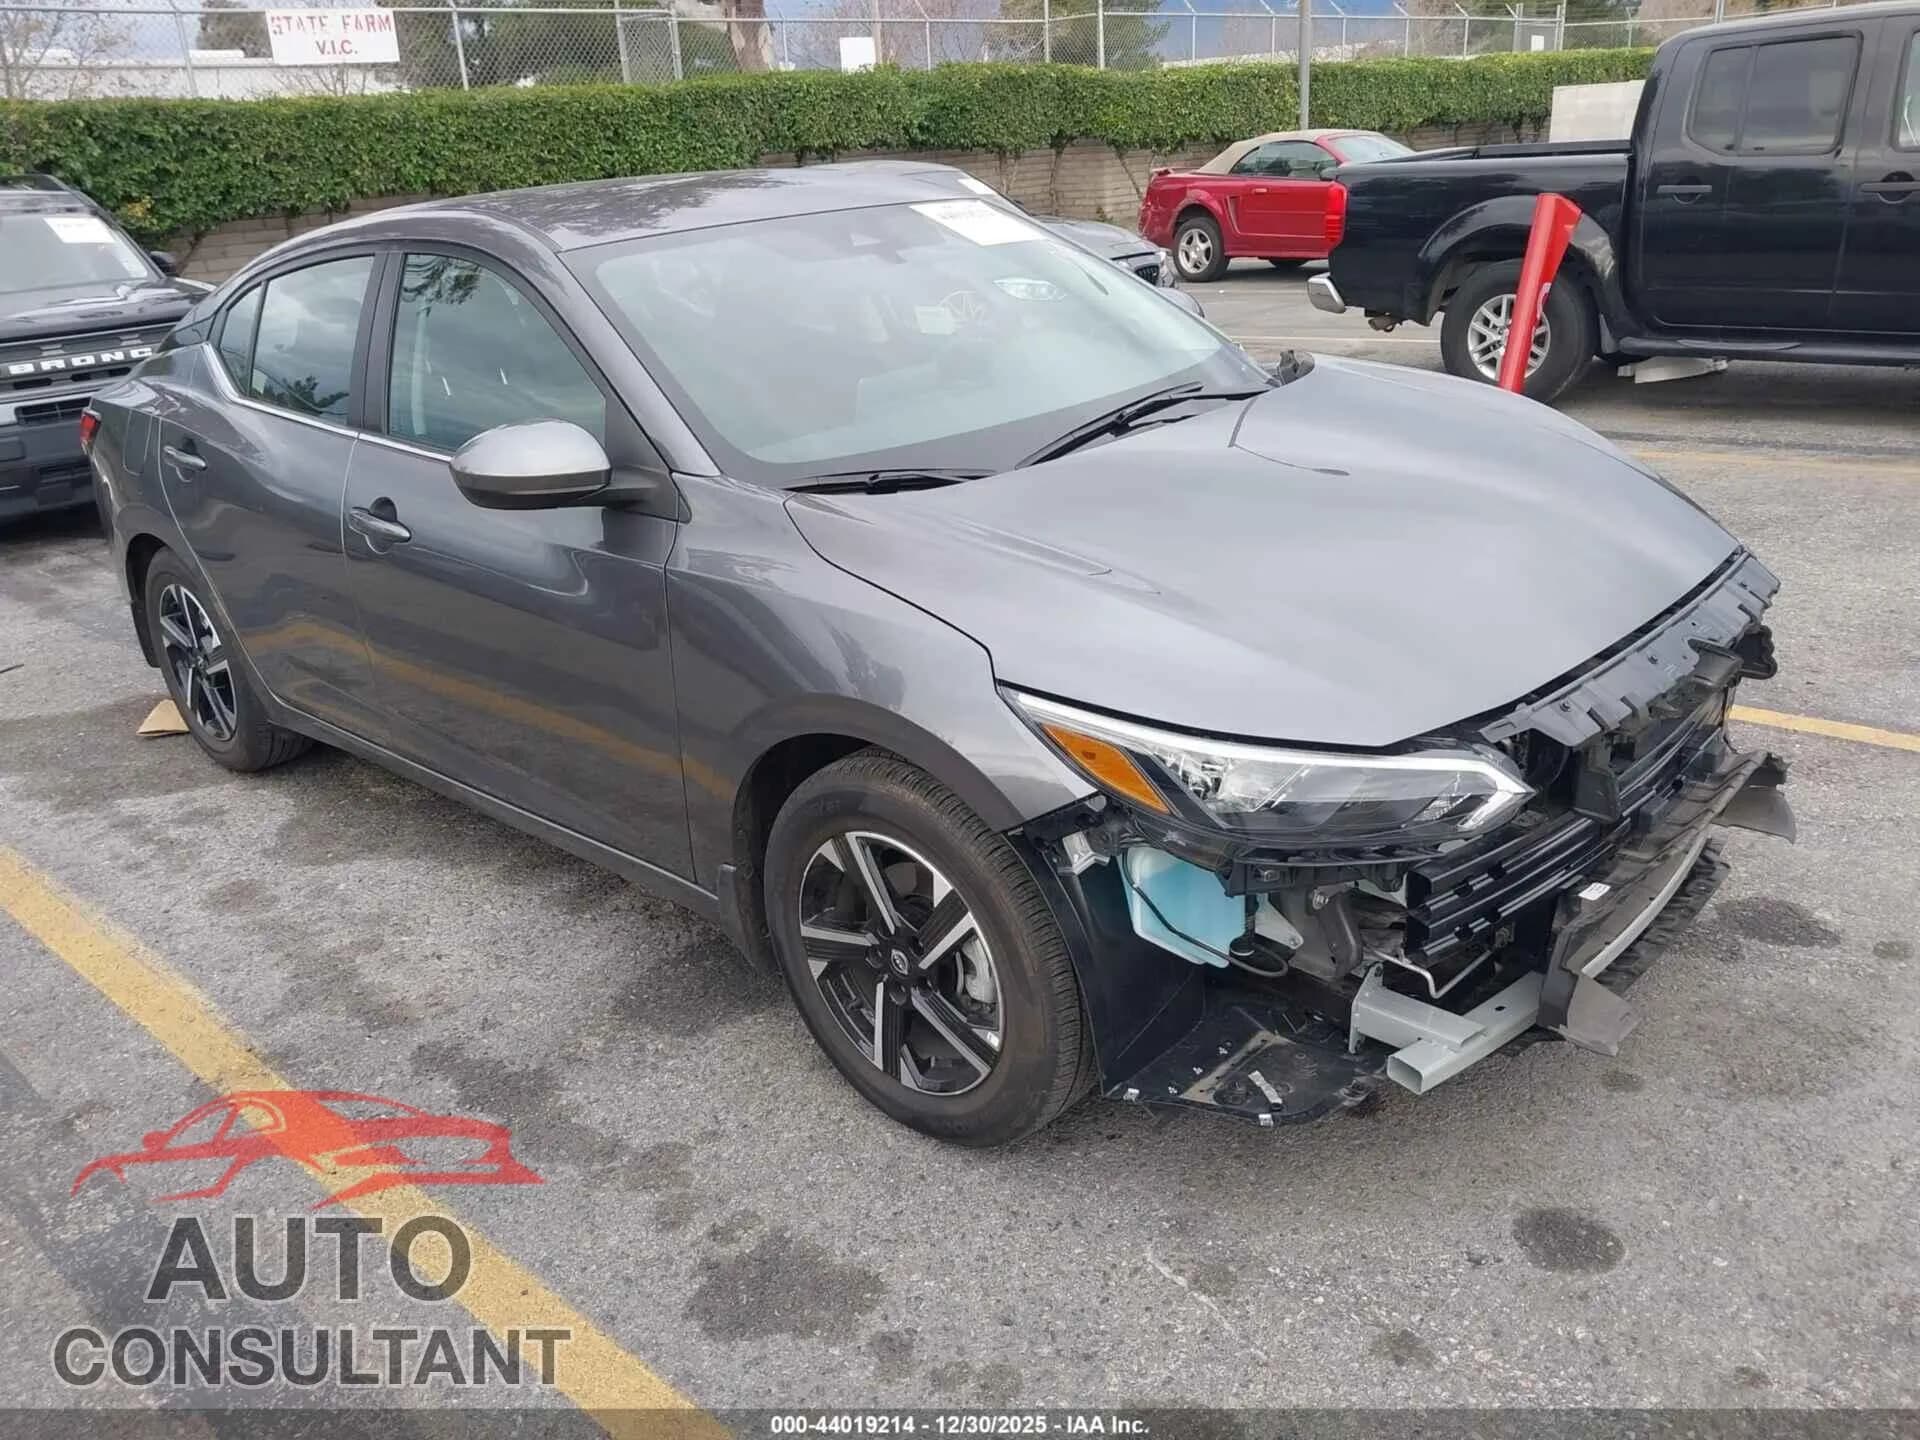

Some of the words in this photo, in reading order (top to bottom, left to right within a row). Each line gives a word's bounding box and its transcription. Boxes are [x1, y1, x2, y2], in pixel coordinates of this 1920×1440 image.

[271, 15, 328, 35] STATE
[341, 14, 392, 33] FARM
[315, 39, 358, 55] V.I.C.
[8, 348, 152, 375] BRONC
